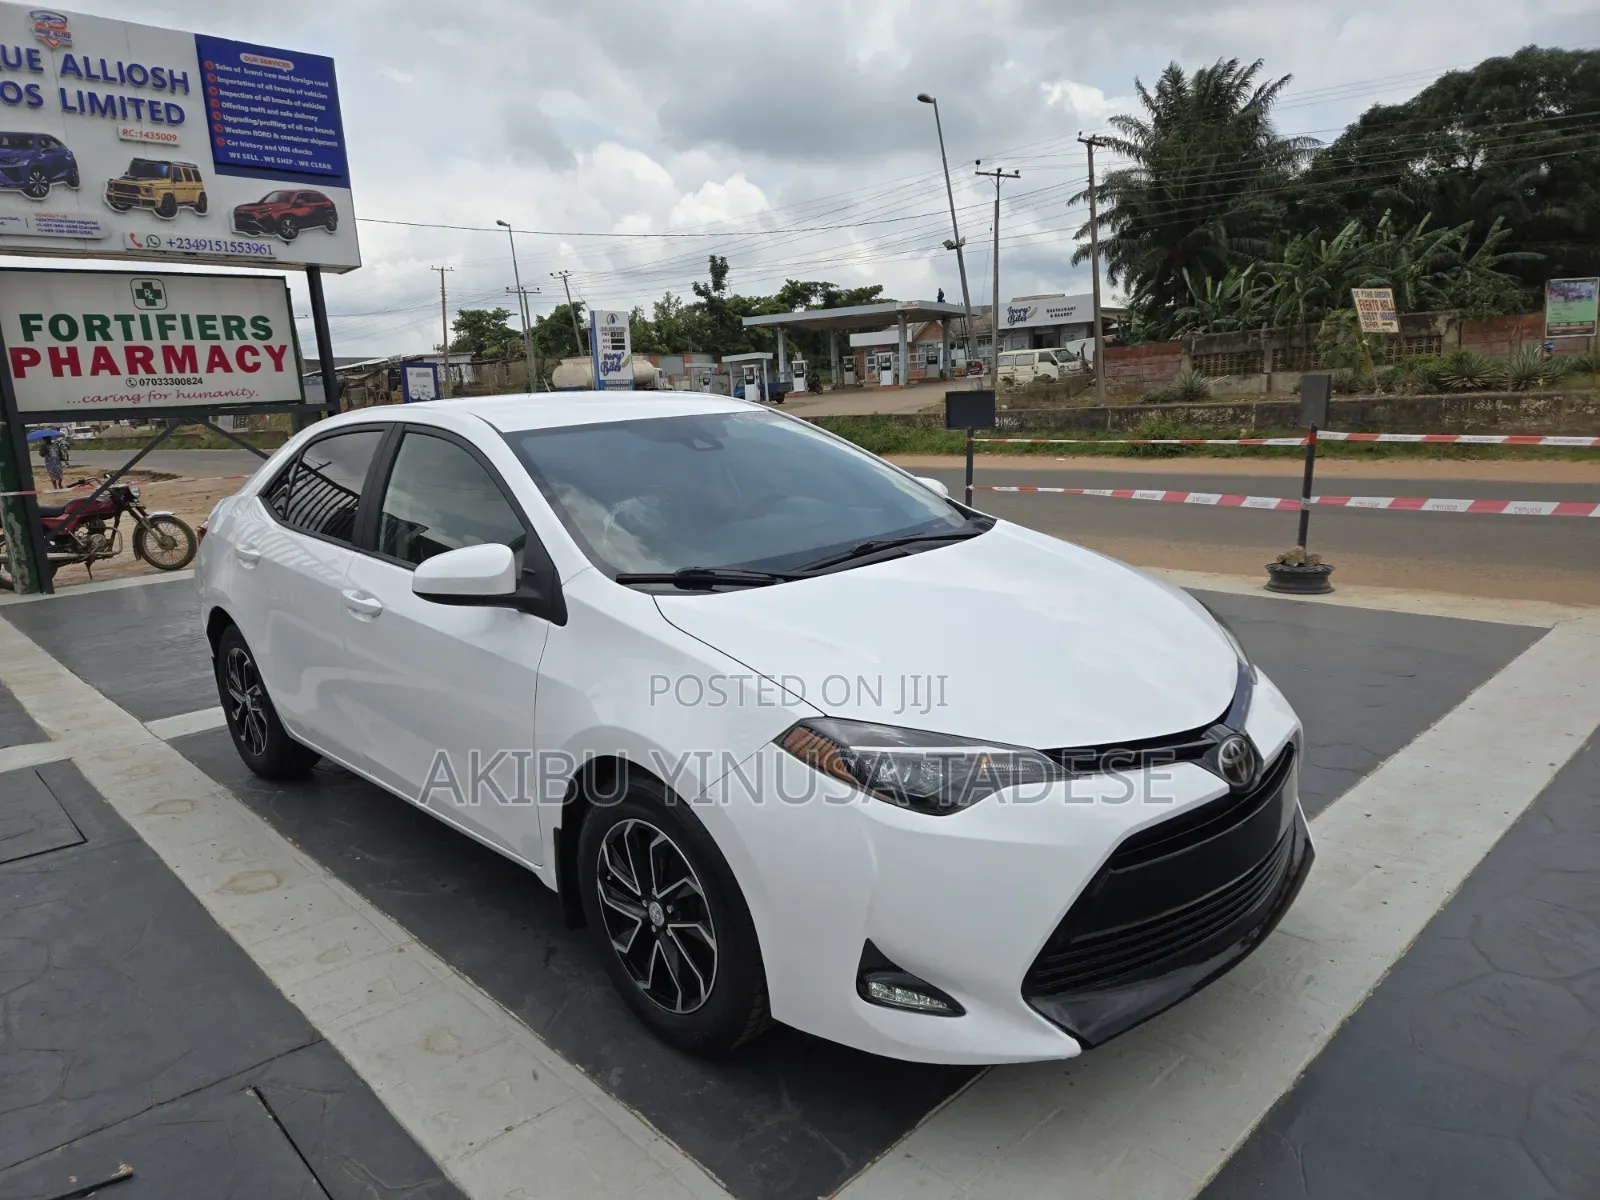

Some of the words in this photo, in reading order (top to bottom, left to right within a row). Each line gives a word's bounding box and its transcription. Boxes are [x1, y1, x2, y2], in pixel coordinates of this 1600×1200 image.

[244, 55, 259, 63] OUR
[260, 57, 291, 68] SERVICES
[60, 53, 190, 95] ALLIOSH
[215, 63, 232, 72] Sales
[244, 67, 263, 77] brand
[263, 71, 277, 79] new
[278, 73, 290, 81] and
[291, 75, 314, 85] foreign
[314, 79, 329, 87] used
[217, 76, 256, 88] Importation
[274, 85, 295, 94] brands
[304, 89, 328, 99] vehicles
[60, 87, 185, 125] LIMITED
[219, 88, 253, 100] Inspection
[271, 96, 293, 106] brands
[301, 102, 326, 111] vehicles
[221, 102, 249, 113] Offering
[249, 106, 266, 114] swift
[266, 108, 279, 116] and
[280, 110, 293, 118] safe
[294, 111, 319, 122] delivery
[122, 128, 177, 142] RC:1435009
[224, 126, 252, 136] Western
[253, 130, 272, 138] RORO
[280, 133, 309, 144] container
[309, 137, 338, 147] shipment
[287, 121, 295, 129] of
[295, 122, 303, 131] all
[314, 126, 335, 135] brands
[240, 140, 263, 151] history
[264, 143, 277, 151] and
[278, 145, 291, 153] VIN
[291, 147, 313, 156] checks
[228, 151, 241, 159] WE
[242, 153, 258, 161] SELL
[276, 157, 293, 165] SHIP
[310, 161, 332, 170] CLEAR
[166, 238, 274, 256] +2349151553961
[1007, 305, 1032, 318] Ivory
[19, 313, 273, 342] FORTIFIERS
[8, 344, 288, 378] PHARMACY
[139, 376, 203, 387] 07033300824
[147, 389, 173, 401] for
[175, 387, 259, 400] humanity.
